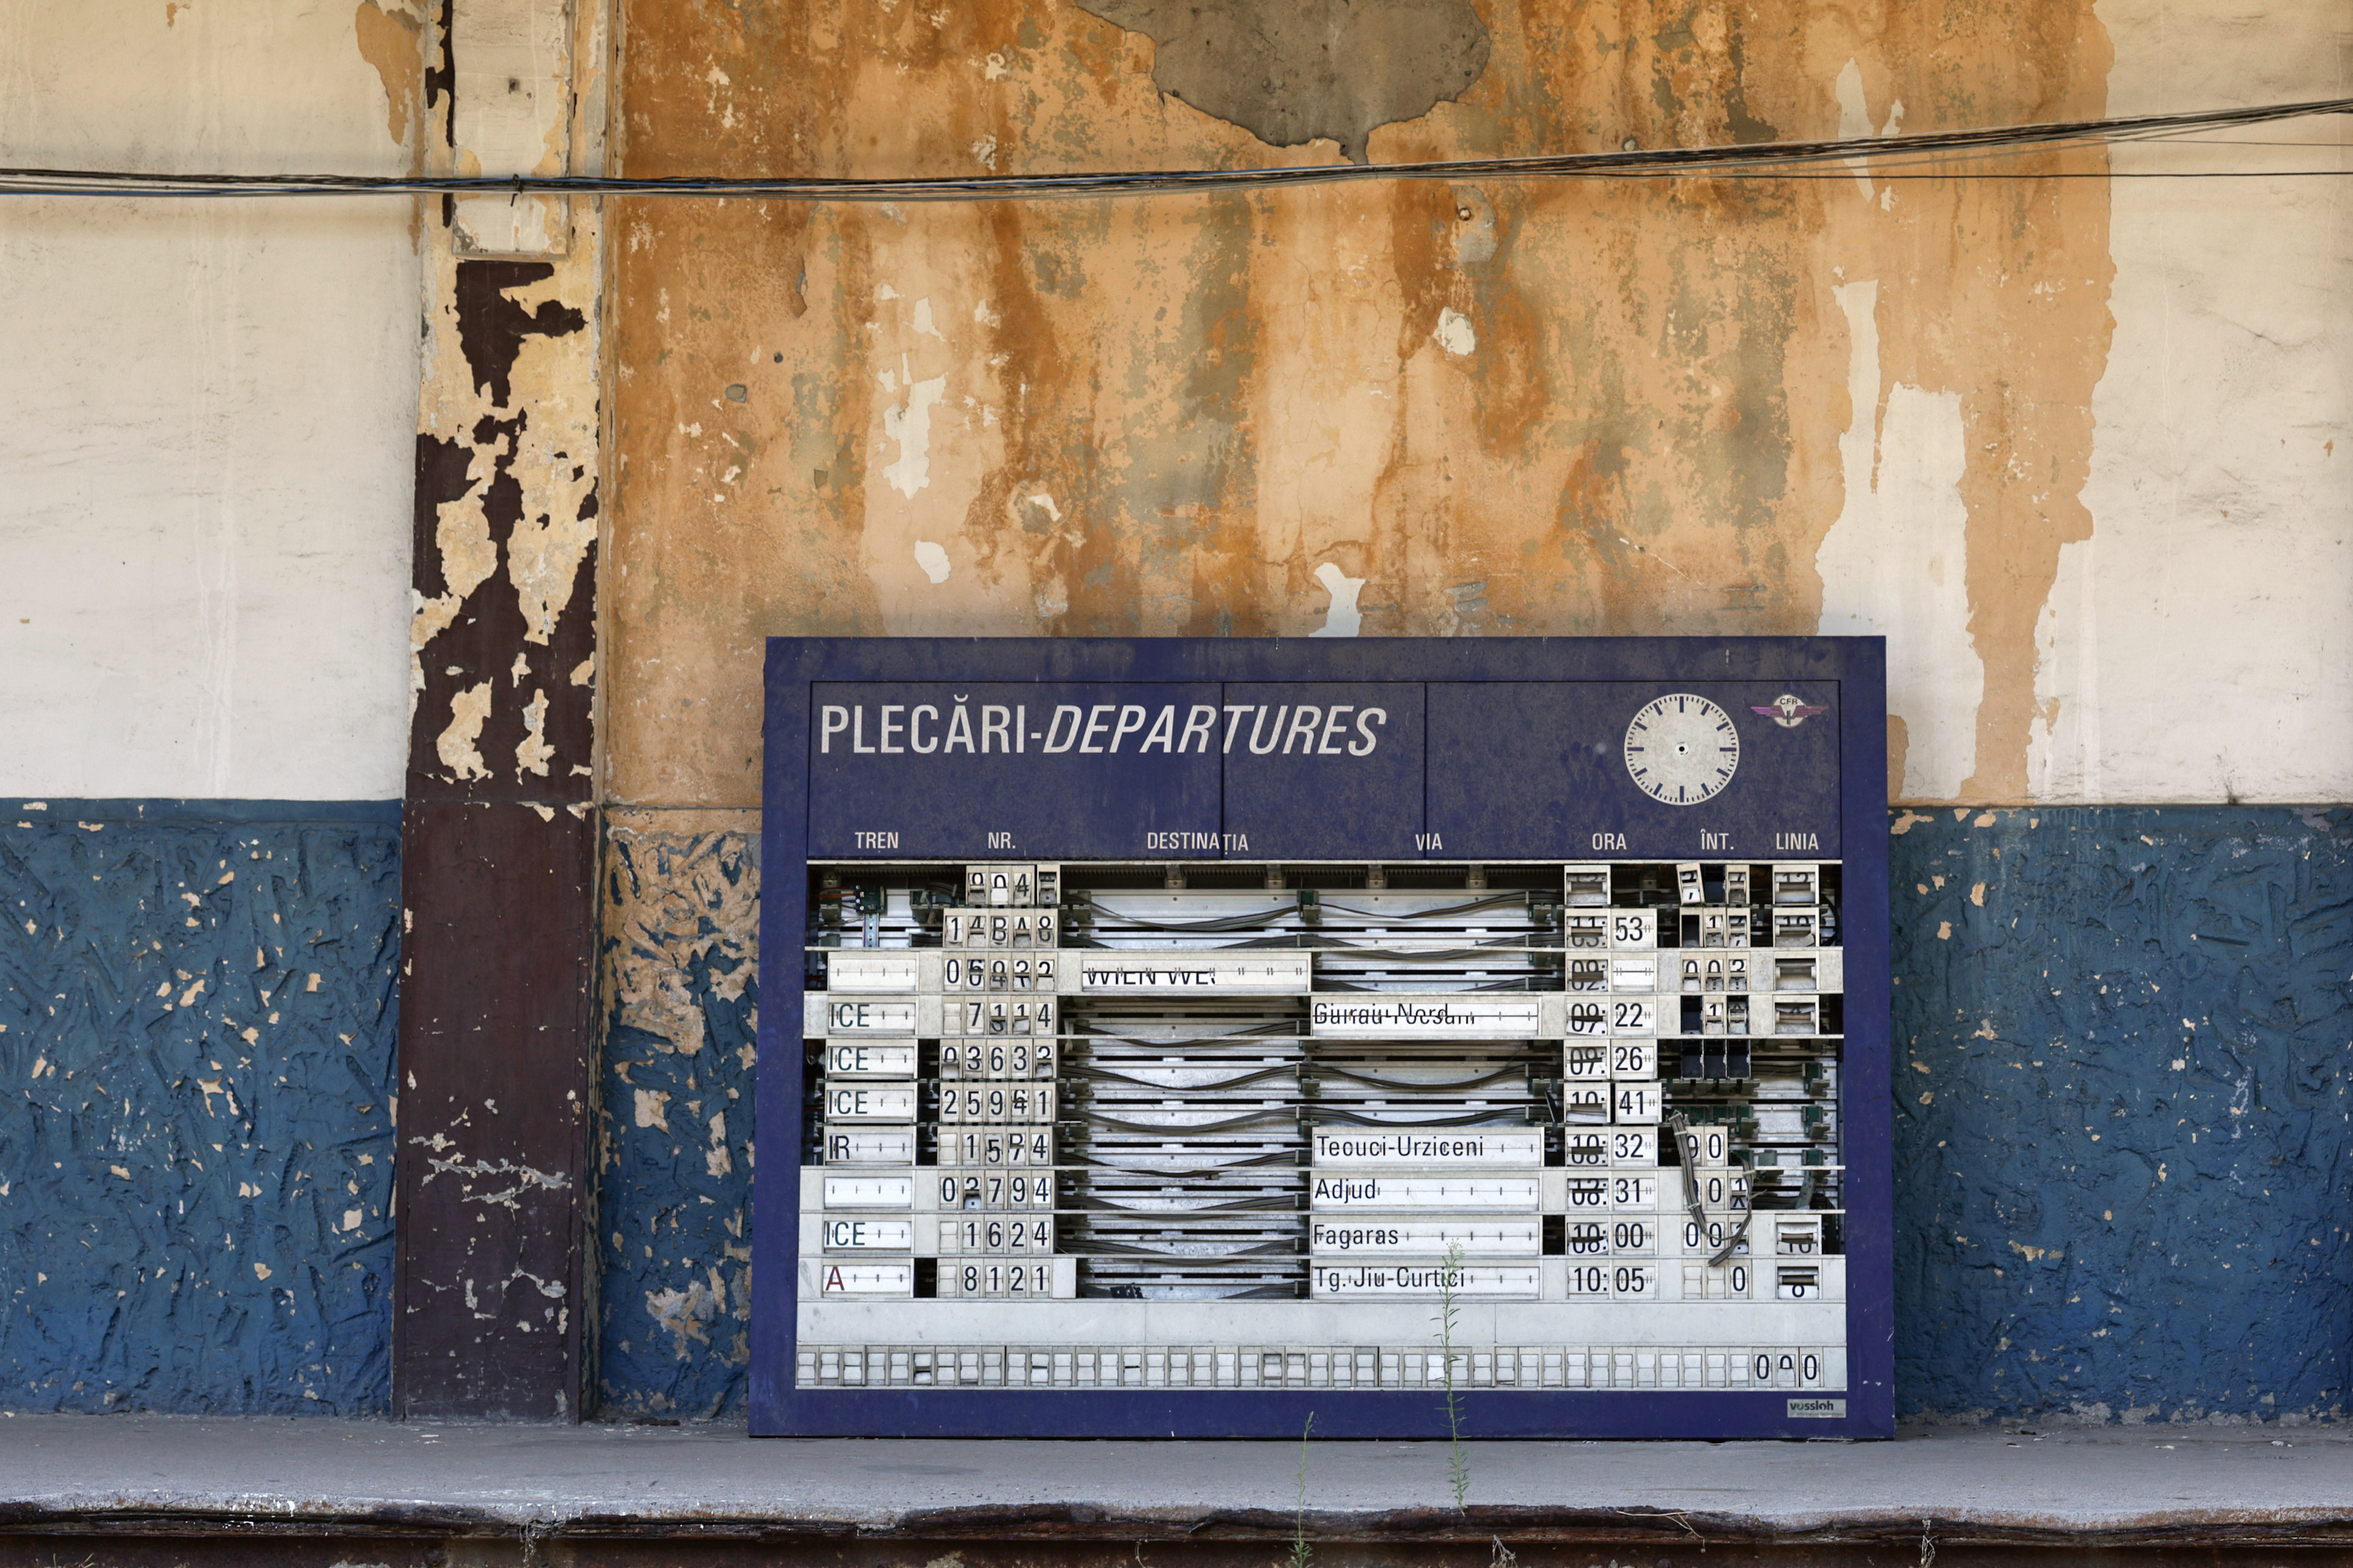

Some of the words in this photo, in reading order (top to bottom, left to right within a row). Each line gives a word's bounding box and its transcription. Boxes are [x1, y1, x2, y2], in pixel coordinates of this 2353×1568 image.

[855, 832, 899, 849] TREN
[988, 833, 1016, 849] NR.
[1415, 833, 1443, 851] VIA
[1592, 833, 1627, 851] ORA
[1776, 833, 1819, 851] LINIA
[831, 1004, 870, 1027] ICE
[829, 1048, 869, 1070] ICE
[829, 1091, 868, 1114] ICE
[829, 1136, 850, 1159] IR
[1315, 1178, 1376, 1203] Adjud
[826, 1222, 865, 1245] ICE
[967, 1222, 1047, 1247] 1624
[1314, 1225, 1399, 1249] Fagaras
[826, 1266, 845, 1291] A
[965, 1266, 1044, 1291] 8121
[1316, 1267, 1346, 1292] Tg.
[1732, 1267, 1746, 1292] 0
[1790, 1400, 1834, 1411] vossloh
